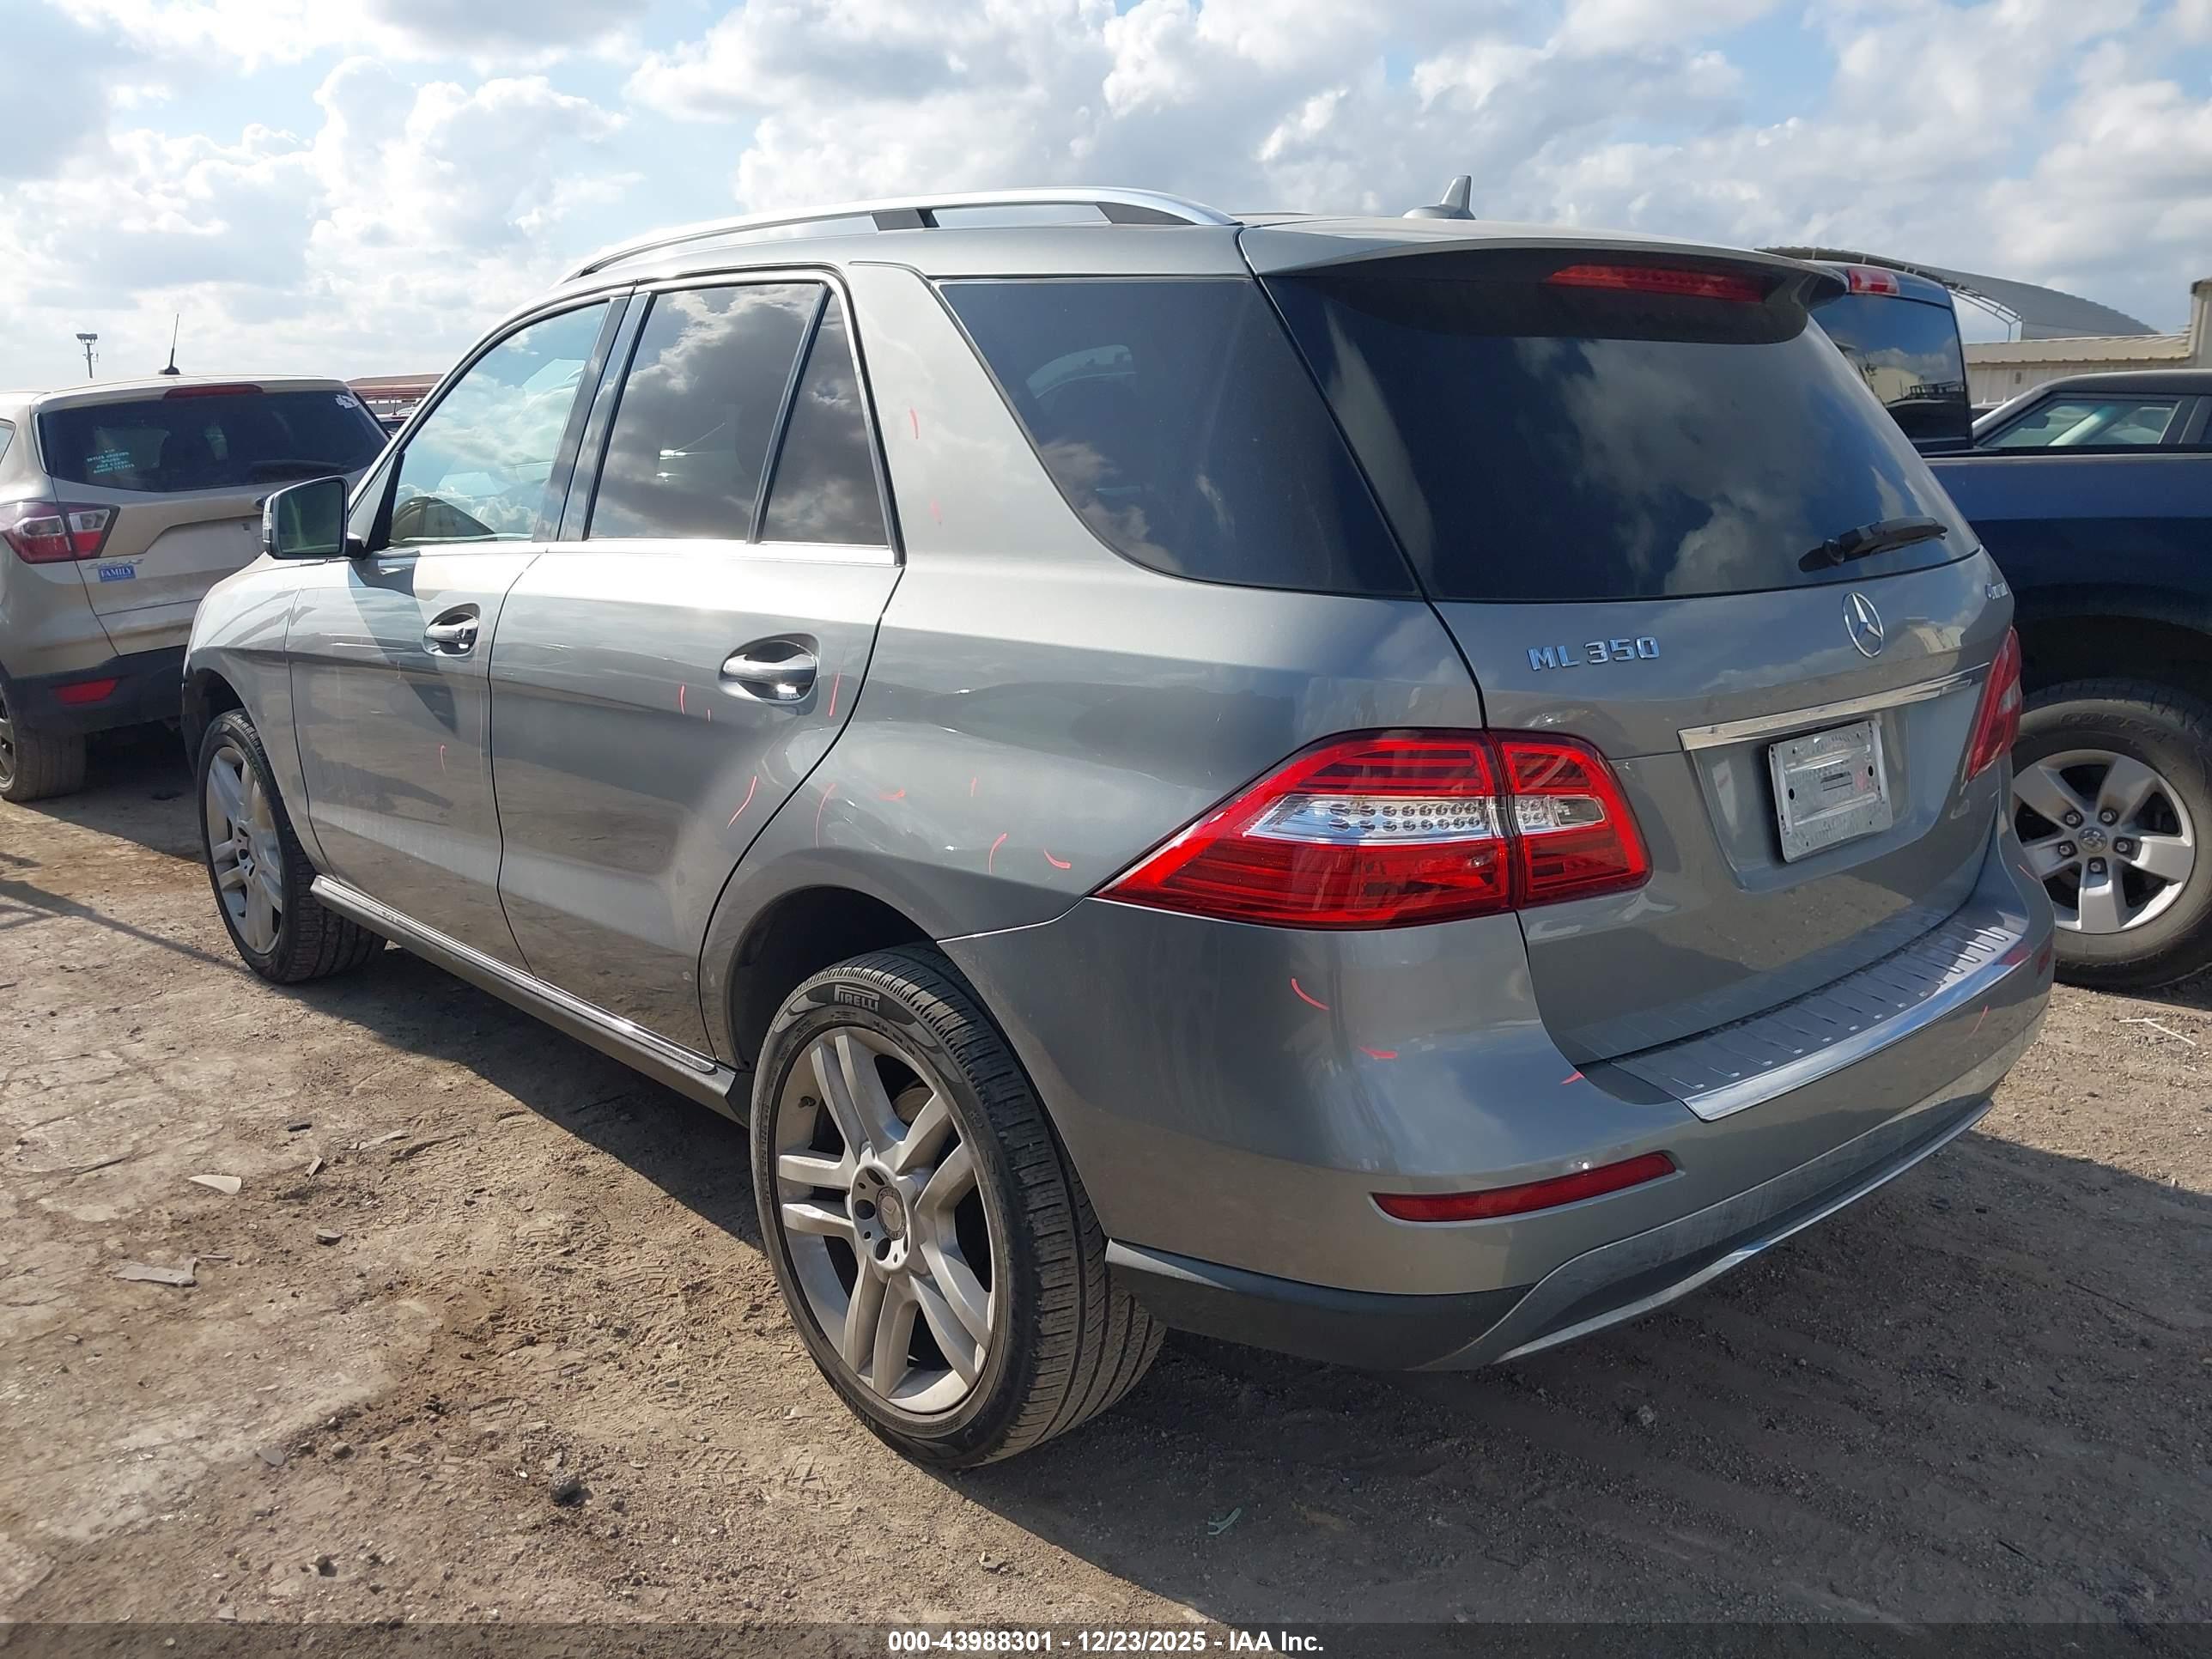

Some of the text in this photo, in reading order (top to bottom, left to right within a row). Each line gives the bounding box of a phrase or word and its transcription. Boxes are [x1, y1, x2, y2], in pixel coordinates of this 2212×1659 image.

[100, 567, 132, 578] FAMILY
[1527, 636, 1661, 671] ML 350
[834, 984, 880, 1012] PIRELLI
